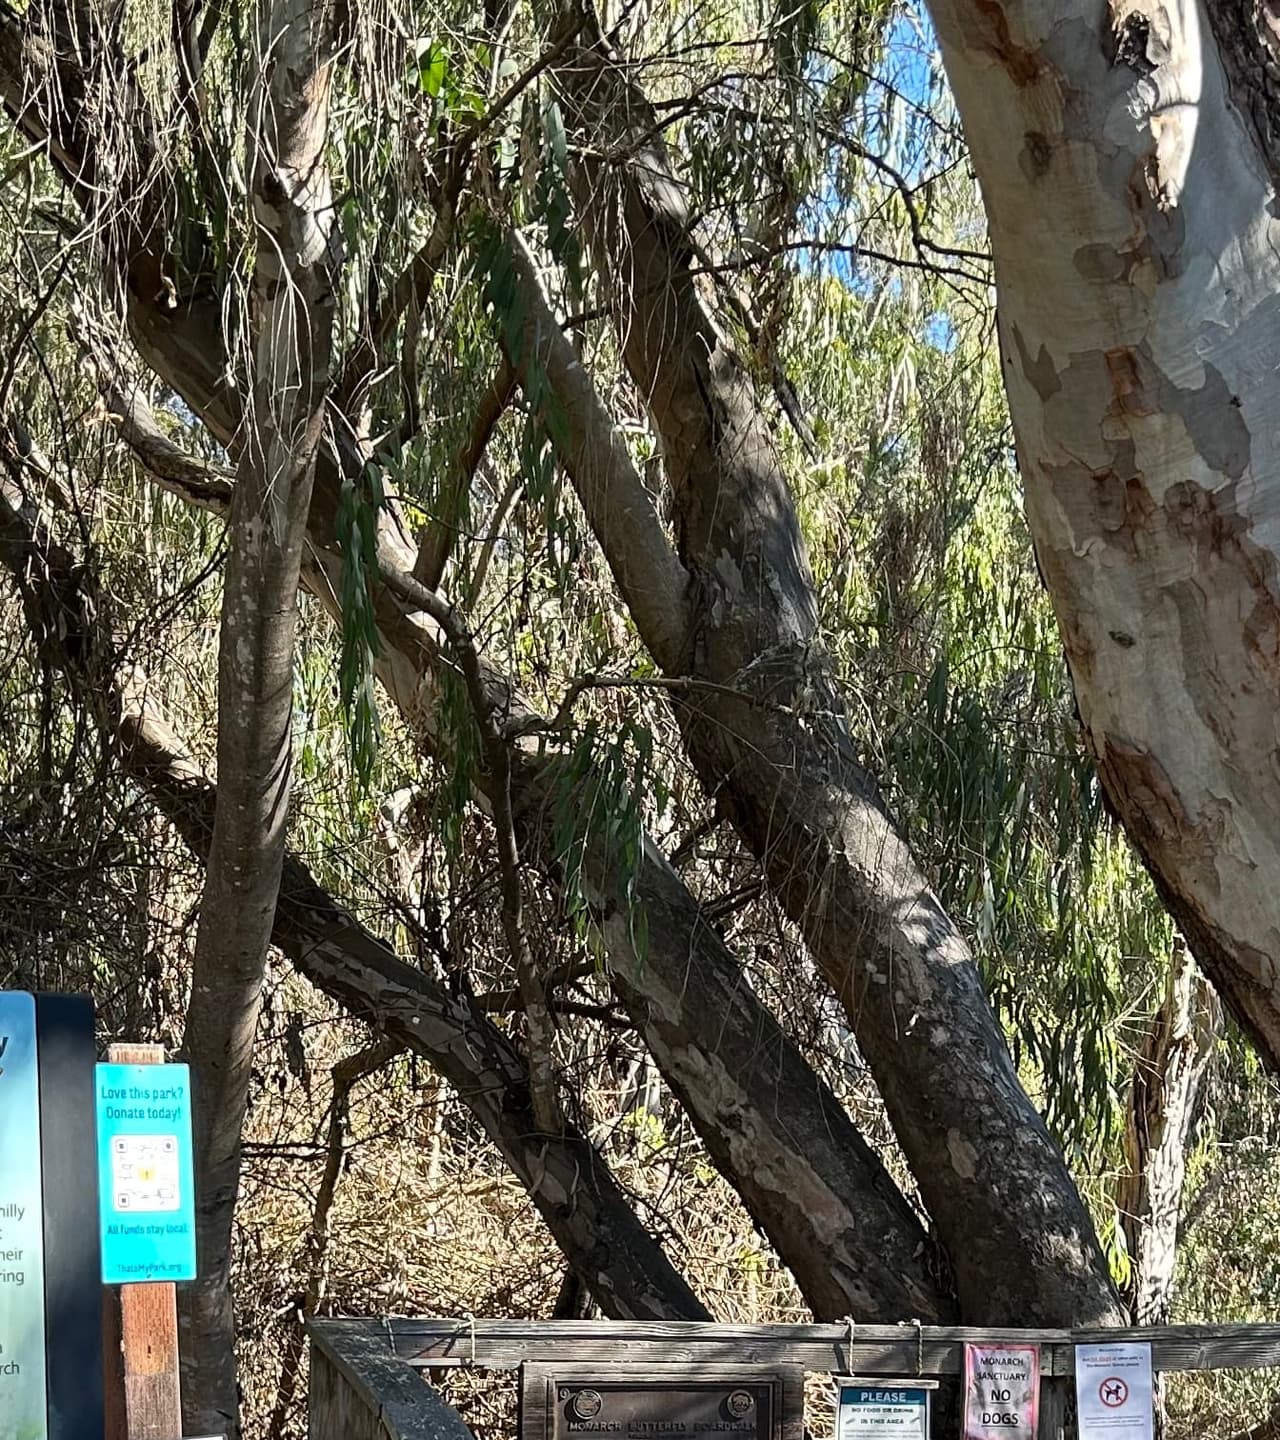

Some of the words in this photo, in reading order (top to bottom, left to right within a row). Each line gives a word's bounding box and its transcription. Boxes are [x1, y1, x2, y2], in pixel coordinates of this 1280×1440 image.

[101, 1085, 126, 1099] Love
[129, 1086, 150, 1099] this
[152, 1086, 183, 1102] park?
[106, 1106, 144, 1119] Donate
[147, 1107, 181, 1122] today!
[981, 1357, 1024, 1366] MONARCH
[977, 1372, 1026, 1380] SANCTUARY
[861, 1392, 907, 1402] PLEASE
[991, 1389, 1011, 1401] NO
[982, 1412, 1019, 1424] DOGS
[568, 1421, 621, 1432] MONARCH
